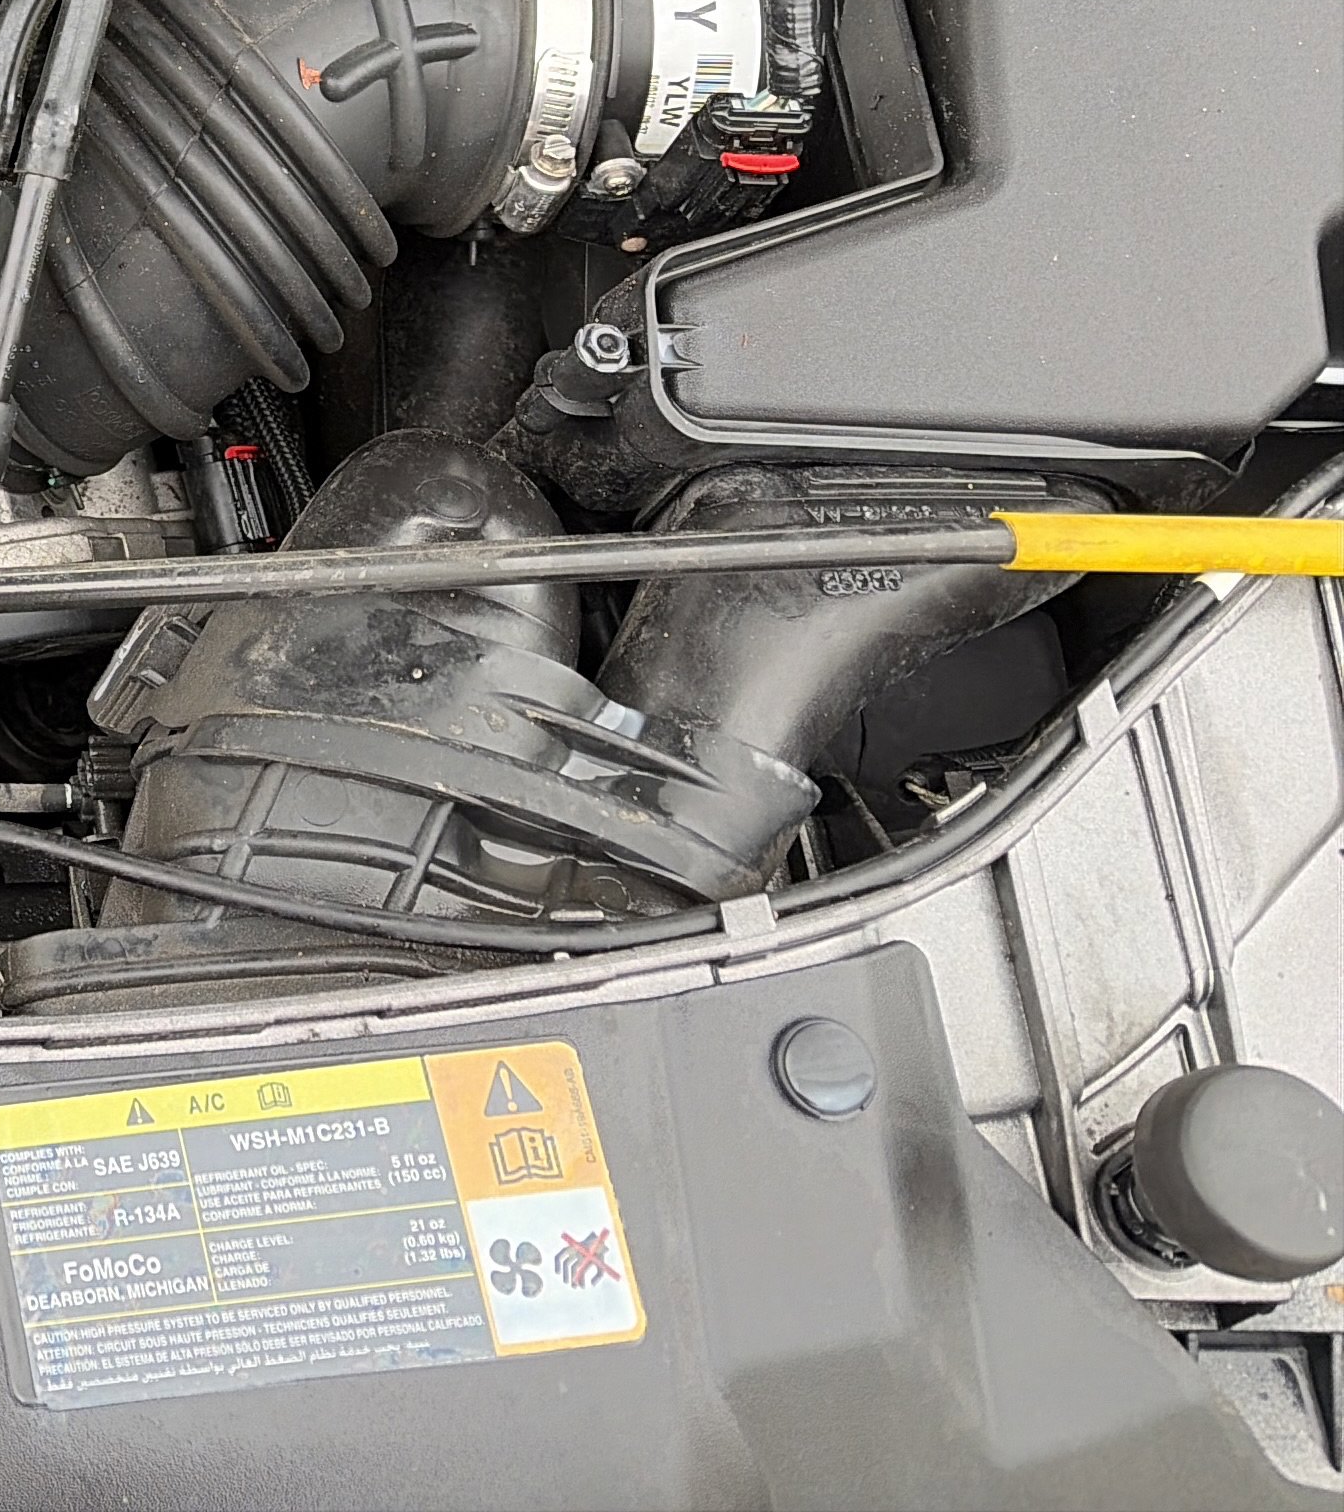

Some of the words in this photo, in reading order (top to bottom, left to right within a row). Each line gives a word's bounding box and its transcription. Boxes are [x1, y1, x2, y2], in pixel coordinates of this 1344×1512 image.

[674, 1, 716, 32] Y
[658, 76, 690, 127] YLW
[186, 1092, 226, 1114] A/C
[228, 1116, 391, 1152] WSH-M1C231-B
[0, 1148, 53, 1163] COMPLIES
[55, 1144, 85, 1156] WITH:
[74, 1157, 88, 1167] LA
[92, 1155, 134, 1176] SAE
[135, 1149, 181, 1171] J639
[390, 1155, 401, 1168] 5
[402, 1153, 415, 1166] fl
[416, 1153, 436, 1165] oz
[193, 1166, 268, 1183] REFRIGERANT
[269, 1164, 287, 1175] OIL
[295, 1159, 328, 1172] SPEC:
[387, 1169, 420, 1186] (150
[421, 1166, 447, 1183] cc)
[196, 1181, 253, 1196] LUBRIFIANT
[260, 1174, 316, 1189] CONFORME
[326, 1171, 340, 1181] LA
[198, 1198, 221, 1209] USE
[222, 1193, 261, 1206] ACEITE
[262, 1189, 292, 1201] PARA
[292, 1178, 382, 1197] REFRIGERANTES
[112, 1202, 181, 1226] R-134A
[201, 1206, 263, 1222] CONFORME
[408, 1218, 426, 1232] 21
[428, 1218, 446, 1230] oz
[208, 1238, 256, 1253] CHARGE
[255, 1233, 294, 1247] LEVEL:
[401, 1233, 436, 1249] (0.60
[437, 1230, 461, 1246] kg)
[211, 1250, 261, 1265] CHARGE:
[403, 1249, 439, 1265] (1.32
[438, 1245, 467, 1262] lbs)
[62, 1251, 162, 1284] FoMoCo
[214, 1264, 255, 1278] CARGA
[255, 1262, 270, 1273] DE
[25, 1284, 125, 1312] DEARBORN,
[126, 1275, 210, 1300] MICHIGAN
[217, 1276, 272, 1292] LLENADO:
[106, 1318, 161, 1336] PRESSURE
[163, 1314, 204, 1329] SYSTEM
[205, 1311, 220, 1324] TO
[220, 1310, 236, 1323] BE
[236, 1303, 288, 1321] SERVICED
[288, 1300, 316, 1315] ONLY
[316, 1298, 333, 1312] BY
[332, 1292, 387, 1310] QUALIFIED
[95, 1338, 137, 1354] CIRCUIT
[137, 1334, 167, 1349] SOUS
[168, 1330, 204, 1346] HAUTE
[204, 1324, 256, 1341] PRESSION
[263, 1316, 330, 1334] TECHNICIENS
[100, 1357, 115, 1369] EL
[114, 1352, 155, 1368] SISTEMA
[155, 1350, 170, 1363] DE
[169, 1348, 193, 1361] ALTA
[261, 1337, 287, 1351] DEBE
[288, 1335, 307, 1347] SER
[308, 1329, 356, 1345] REVISADO
[355, 1326, 377, 1339] POR
[376, 1321, 427, 1337] PERSONAL
